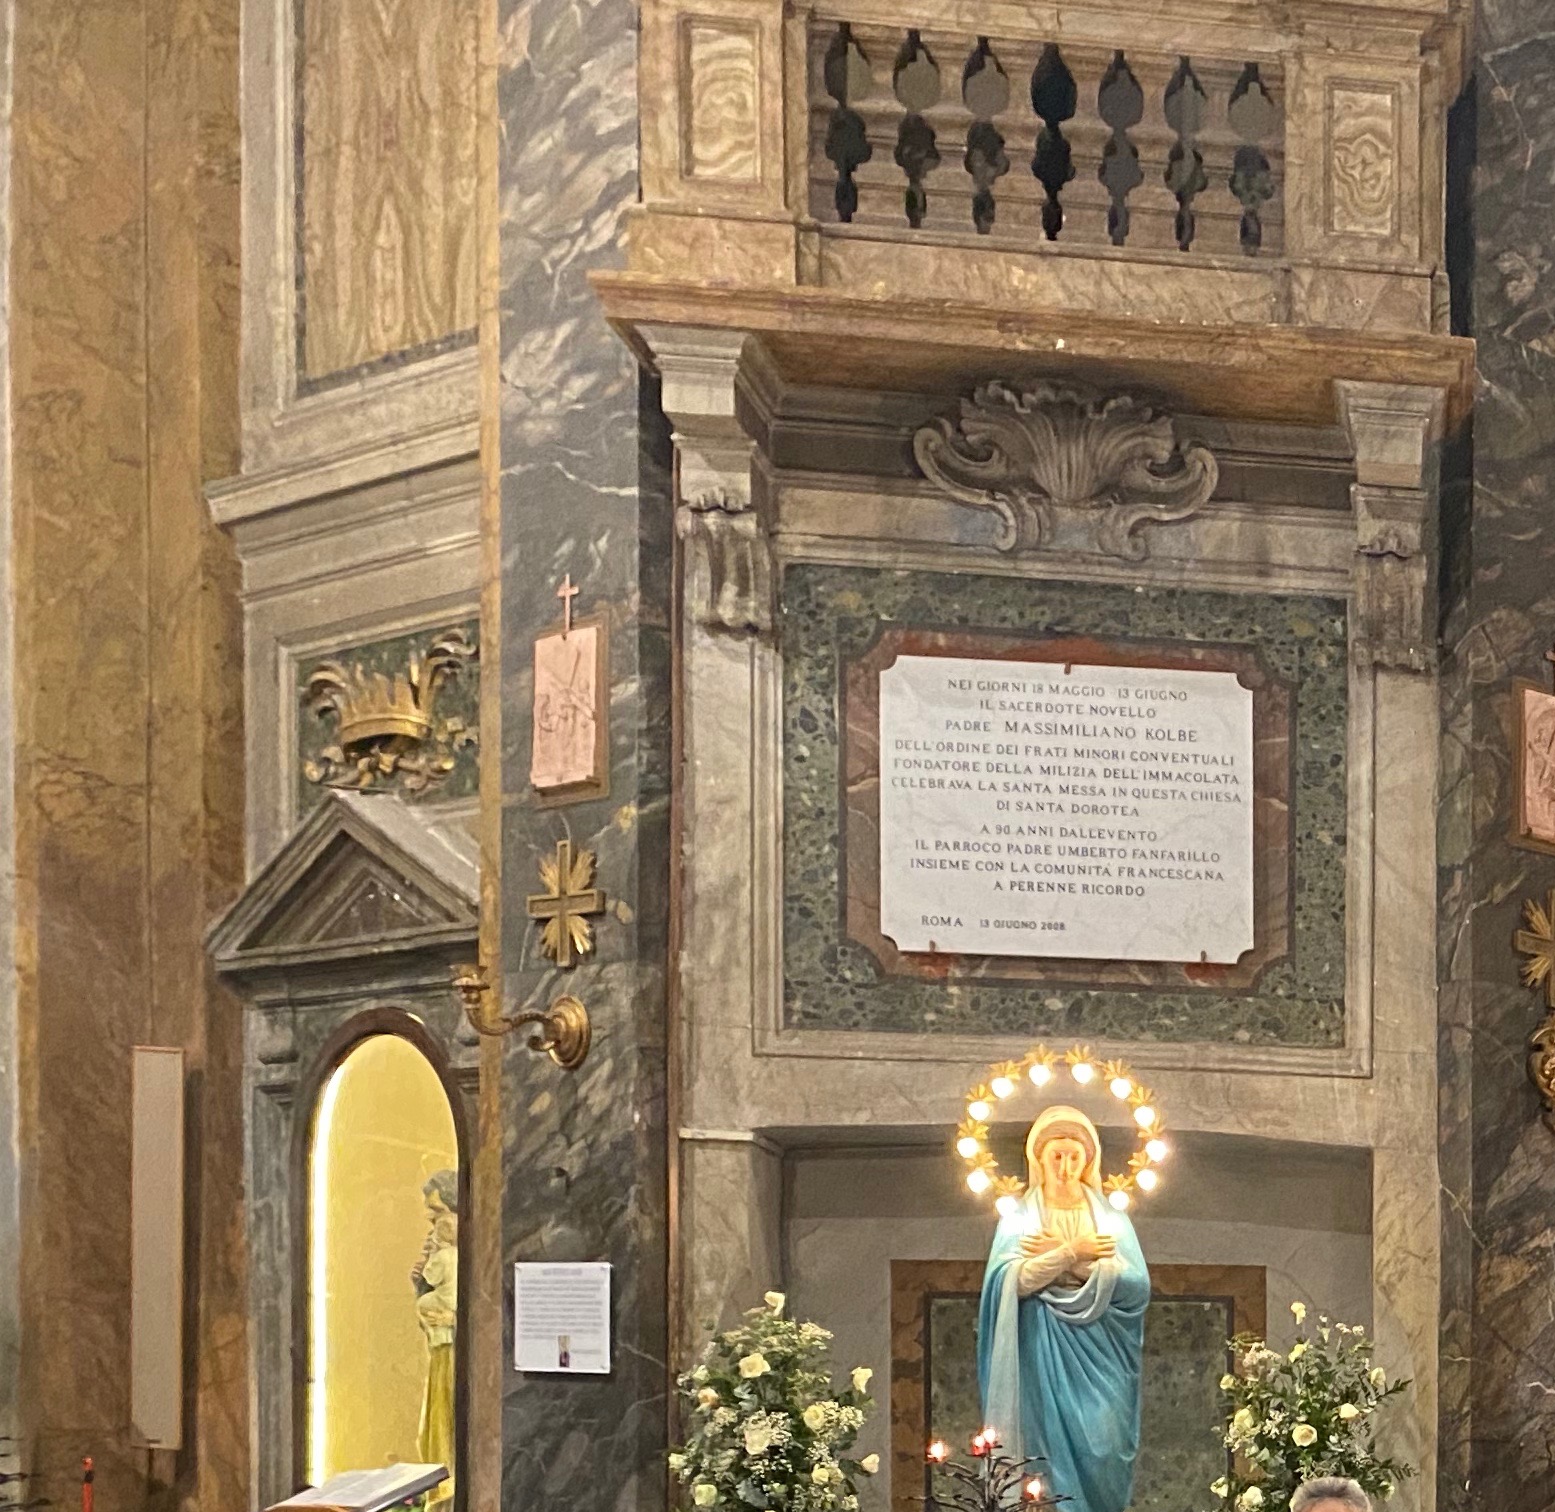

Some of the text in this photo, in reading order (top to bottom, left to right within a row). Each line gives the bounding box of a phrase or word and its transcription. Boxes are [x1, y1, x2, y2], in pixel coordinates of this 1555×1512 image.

[948, 680, 972, 691] NEI
[978, 680, 1026, 693] GIORNI
[1048, 684, 1105, 698] MAGGIO
[1117, 688, 1130, 699] 13
[1135, 688, 1188, 701] GIUGNO
[980, 699, 1156, 718] IL SACERDOTE NOVELLO
[946, 720, 1197, 742] PADRE MASSIMILIANO KOLBE
[996, 745, 1019, 756] DEI
[1024, 746, 1068, 758] FRATI
[1074, 748, 1125, 760] MINORI
[1130, 750, 1234, 766] CONVENTUALI
[894, 760, 1240, 785] FONDATORE DELLA MILIZIA DELL'IMMACOLATA
[891, 778, 1242, 803] CELEBRAVA LA SANTA MESSA IN QUESTA CHIESA
[996, 800, 1139, 817] DI SANTA DOROTEA
[980, 824, 990, 834] A
[1016, 825, 1053, 837] ANNI
[915, 839, 1220, 863] IL PARROCO PADRE UMBERTO FANFARILLO
[910, 858, 970, 871] INSIEME
[975, 860, 1004, 872] CON
[1010, 862, 1030, 873] LA
[1117, 866, 1224, 882] FRANCESCANA
[994, 881, 1145, 897] A PERENNE RICORDO
[921, 915, 963, 928] ROMA
[980, 919, 990, 928] 13
[994, 920, 1037, 930] GIUGNO
